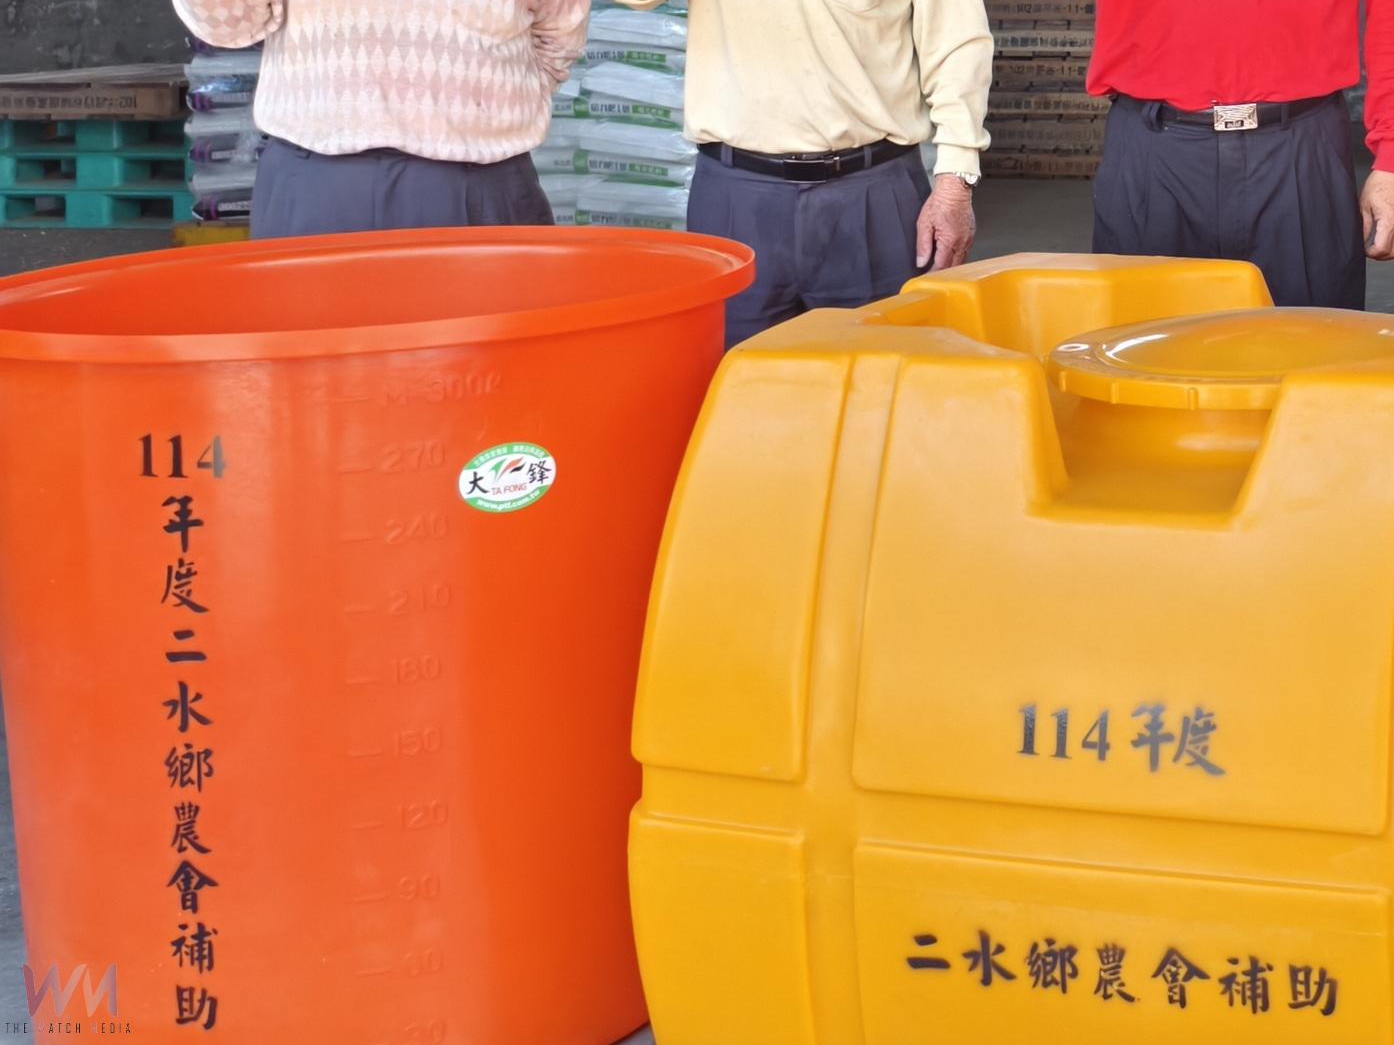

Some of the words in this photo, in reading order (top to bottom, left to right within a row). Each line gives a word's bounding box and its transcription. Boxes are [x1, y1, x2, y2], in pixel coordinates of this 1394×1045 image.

[491, 486, 502, 496] TA
[503, 483, 528, 494] FONG
[905, 929, 1340, 1017] 二水鄉農會補助
